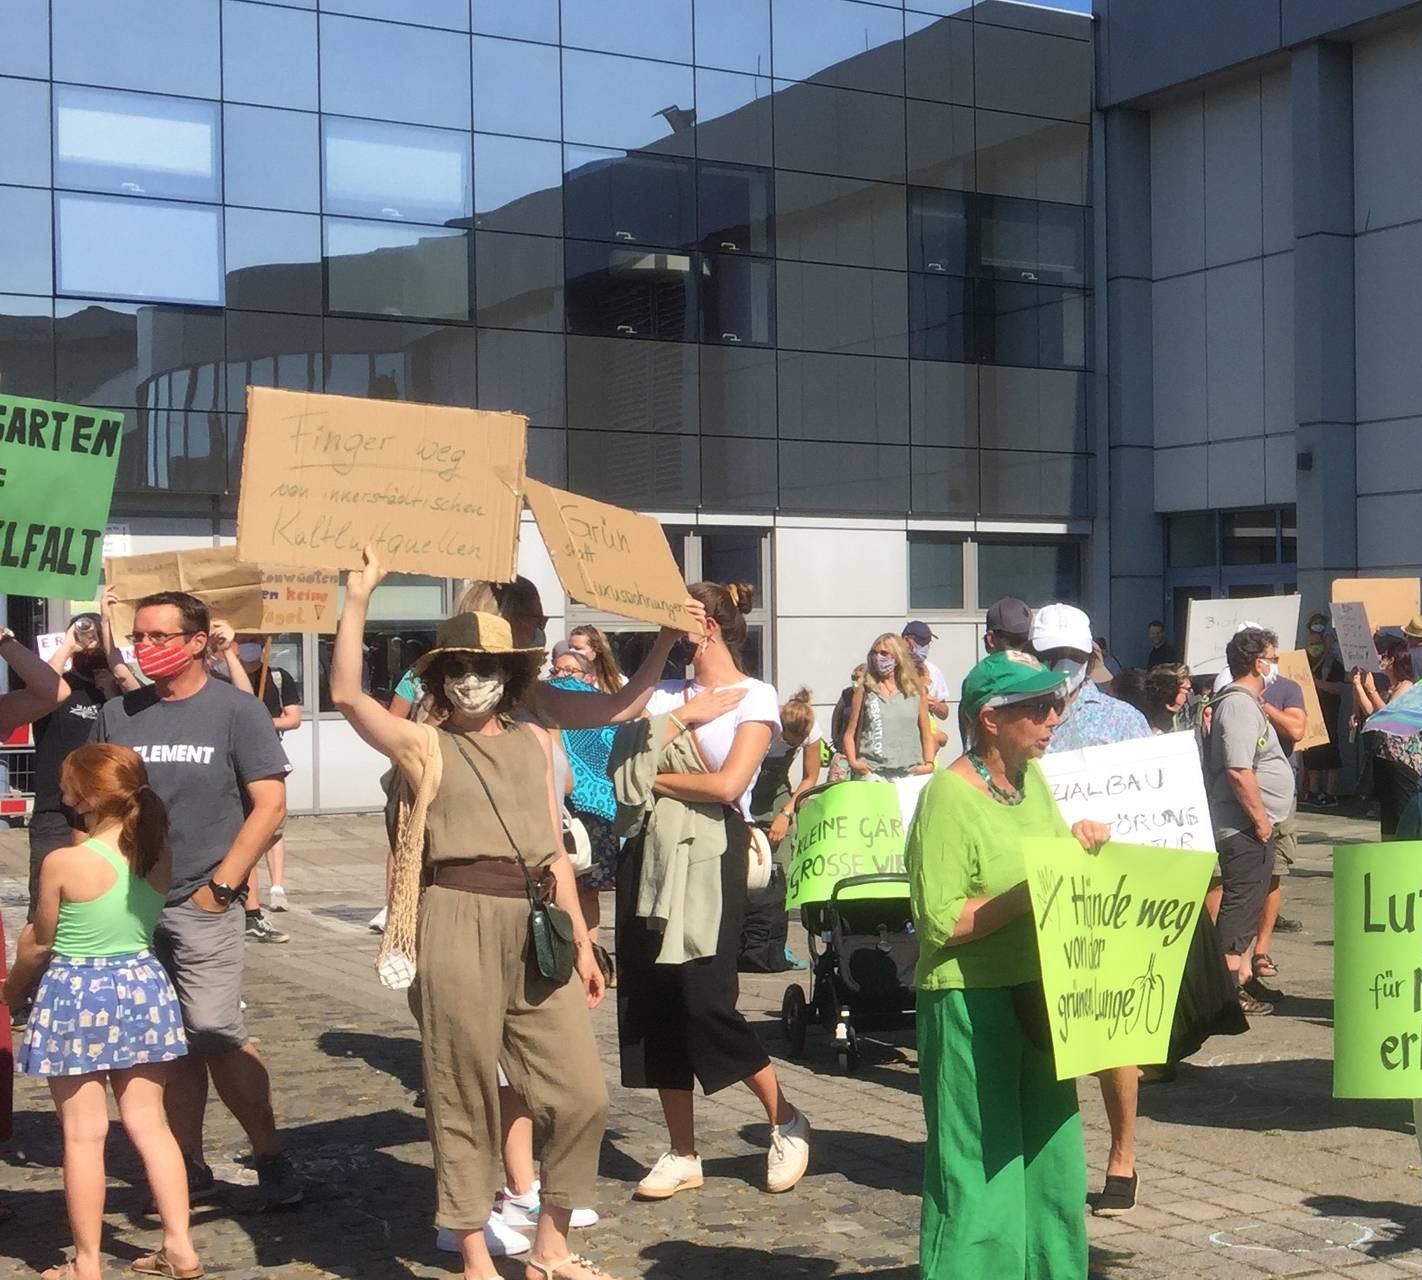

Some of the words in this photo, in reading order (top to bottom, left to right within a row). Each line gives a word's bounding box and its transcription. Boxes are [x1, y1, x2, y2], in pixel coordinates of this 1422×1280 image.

[281, 411, 396, 473] Finger
[417, 440, 466, 481] weg
[270, 483, 309, 497] von
[0, 521, 102, 575] LFALT
[559, 505, 630, 553] Grün
[1071, 874, 1131, 930] Hände
[1136, 898, 1196, 947] weg
[1369, 970, 1405, 1009] für
